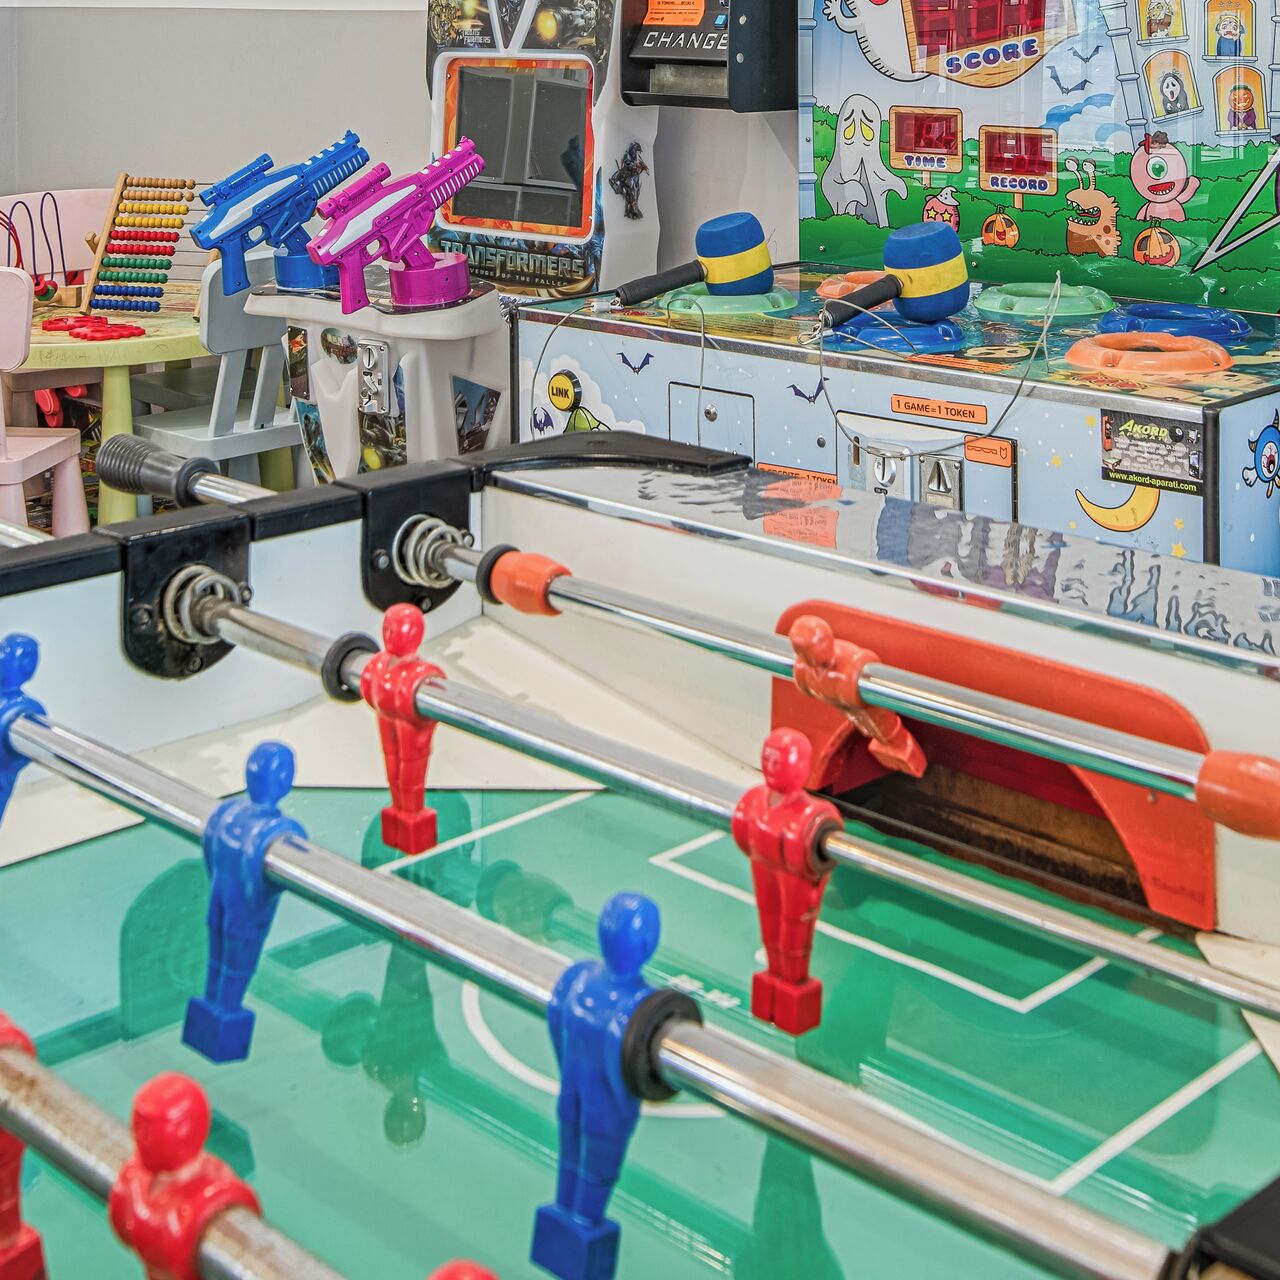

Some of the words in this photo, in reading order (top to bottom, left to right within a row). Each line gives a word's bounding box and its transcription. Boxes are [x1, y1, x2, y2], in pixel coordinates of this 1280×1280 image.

[642, 31, 728, 50] CHANGE
[945, 38, 1041, 75] SCORE
[903, 154, 948, 170] TIME
[989, 175, 1049, 193] RECORD
[515, 275, 531, 283] THE
[551, 386, 569, 399] LINK
[896, 399, 902, 409] 1
[904, 402, 942, 415] GAME=1
[944, 407, 975, 419] TOKEN
[1119, 419, 1169, 437] AKORD
[1109, 472, 1197, 492] www.akord-aparati.com
